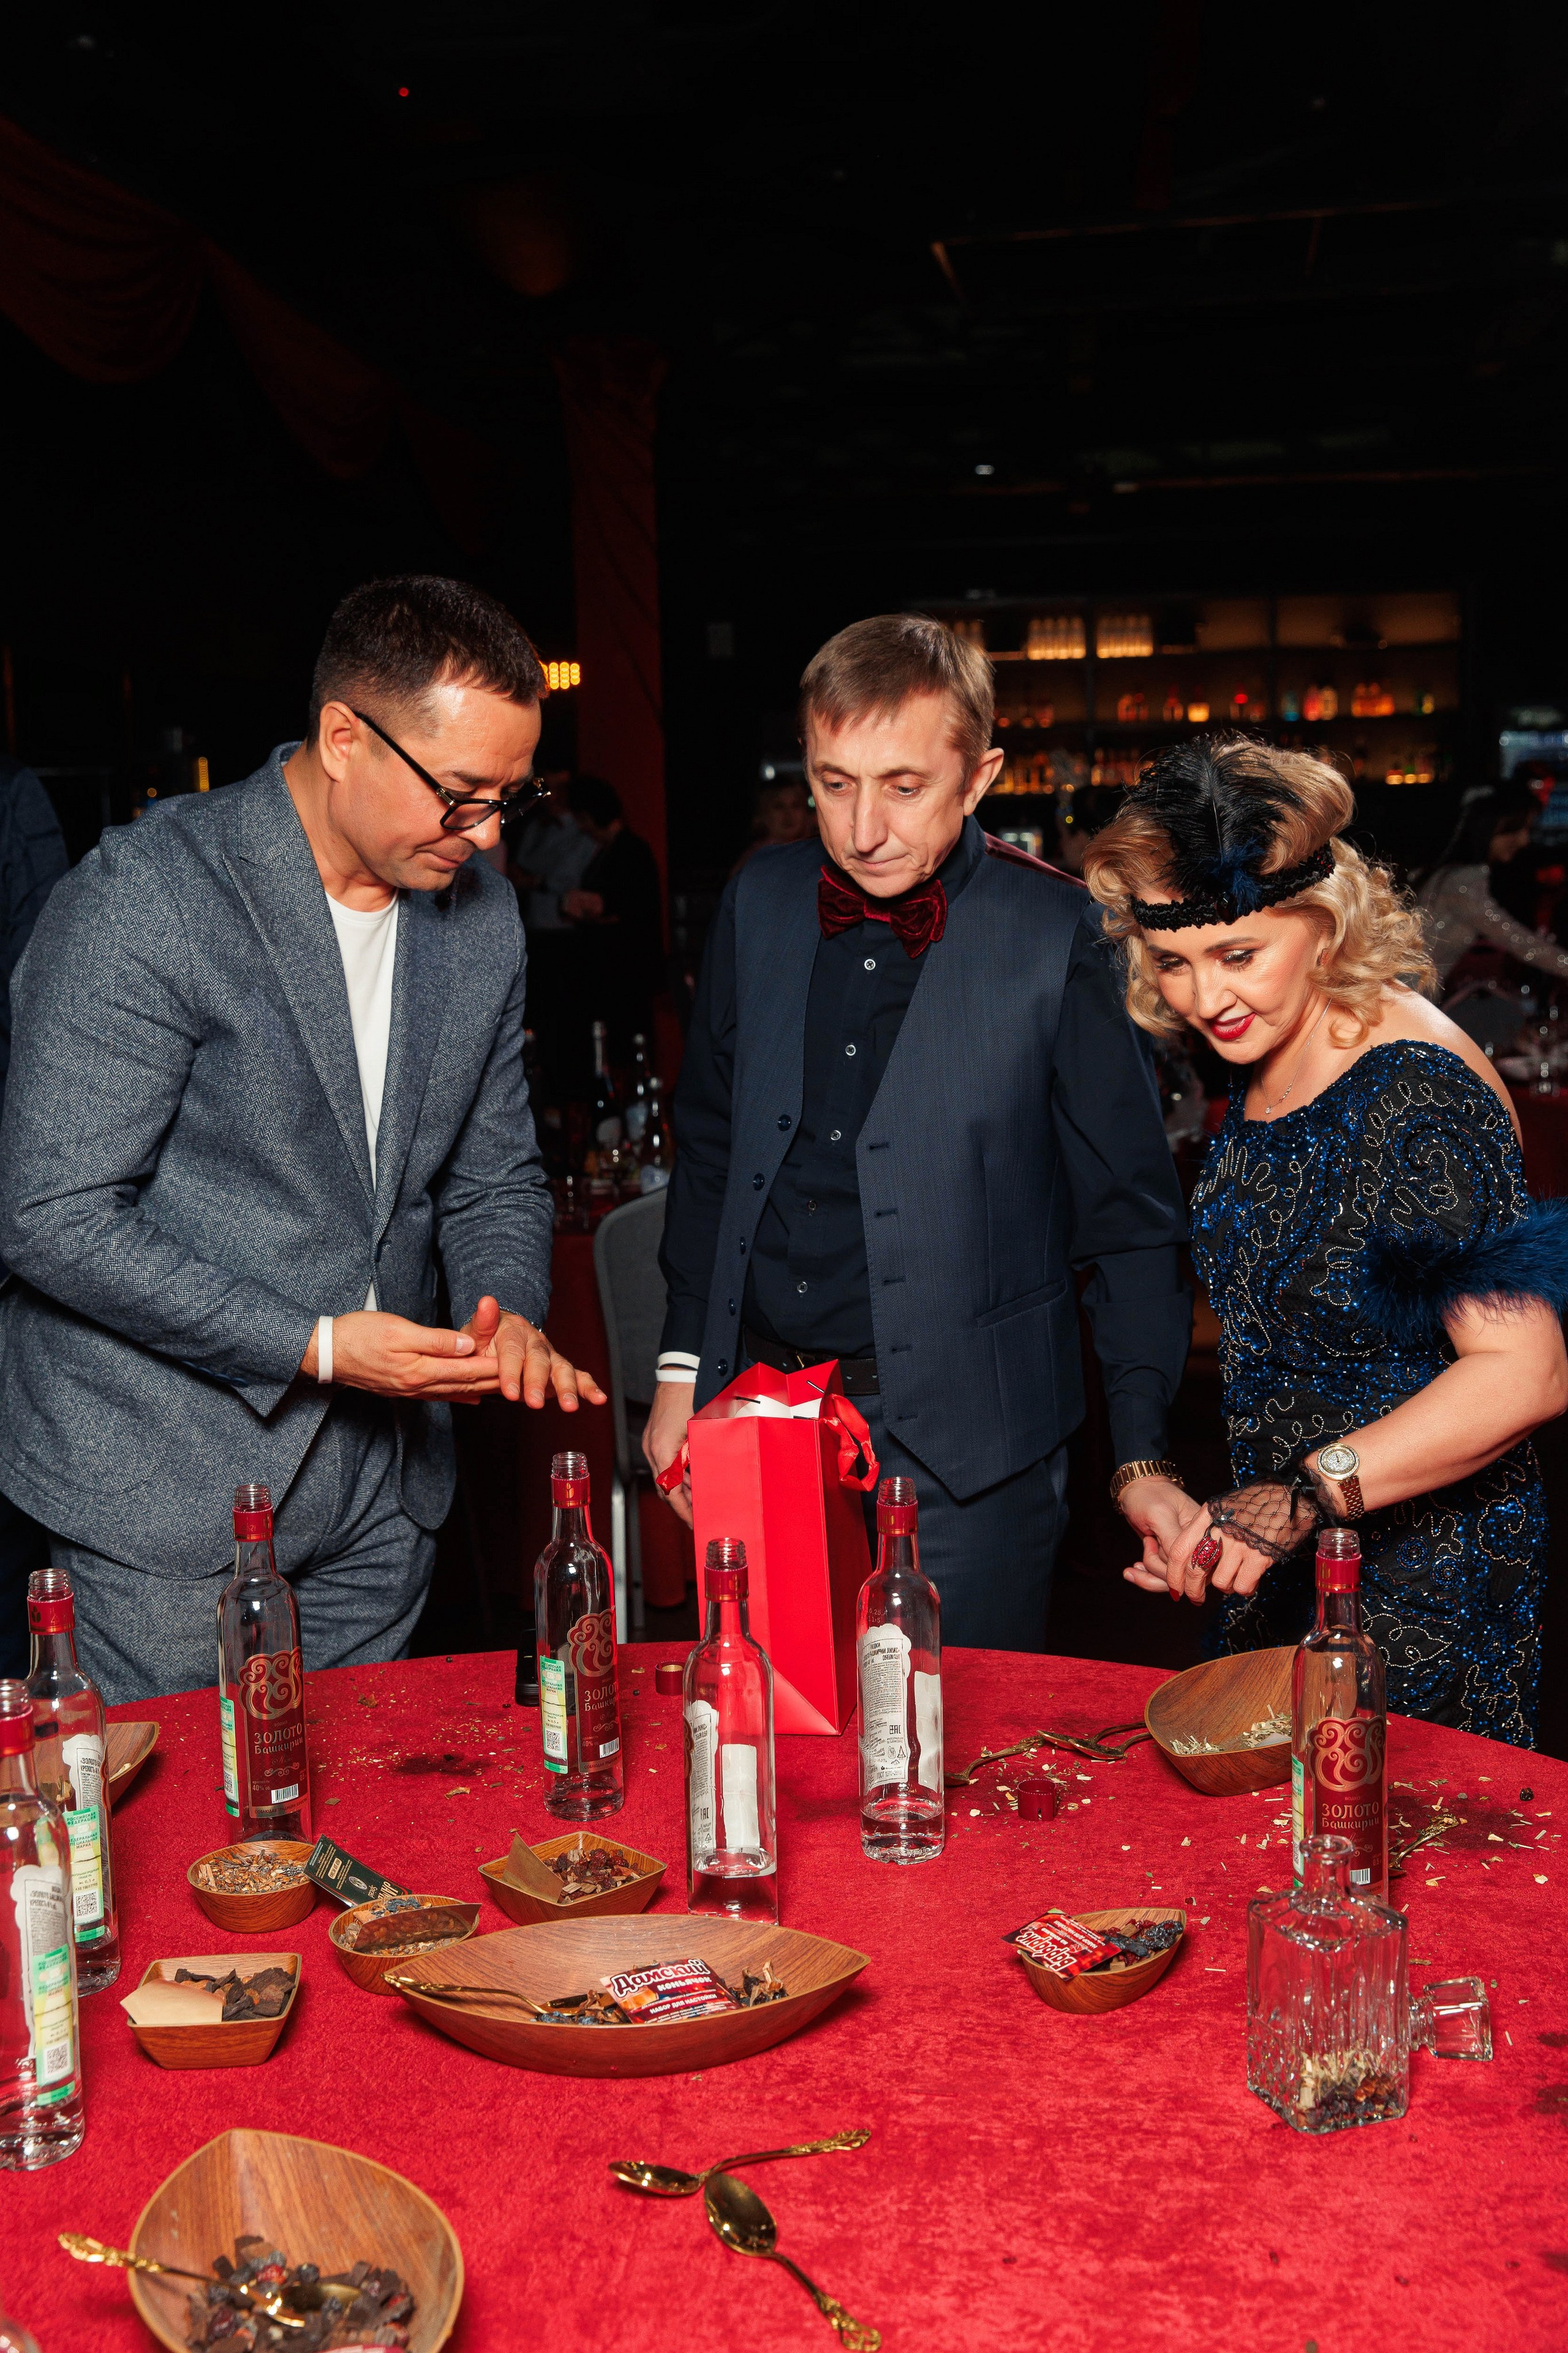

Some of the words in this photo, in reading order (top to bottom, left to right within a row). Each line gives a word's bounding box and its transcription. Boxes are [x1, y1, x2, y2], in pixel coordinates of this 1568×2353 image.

[254, 1723, 302, 1744] ЗОЛОТО
[254, 1737, 303, 1754] Башкирии
[67, 1811, 96, 1821] РОССИЙСКАЯ
[1322, 1801, 1379, 1819] ЗОЛОТО
[67, 1815, 96, 1825] ФЕДЕРАЦИЯ
[1322, 1816, 1379, 1831] Башкирии
[70, 1832, 97, 1843] ЕДЕРАЛЬНАЯ
[70, 1836, 98, 1846] ПЕЦИАЛЬНАЯ
[368, 1884, 378, 1899] Spiced
[1073, 1932, 1085, 1943] ДЛЯ
[1082, 1938, 1098, 1949] НАБОР
[1016, 1931, 1077, 1972] Барбарис
[610, 1958, 711, 1998] Дамский
[649, 2003, 671, 2014] НАБОР
[671, 2000, 685, 2009] ДЛЯ
[684, 1993, 718, 2006] НАСТОЙКИ
